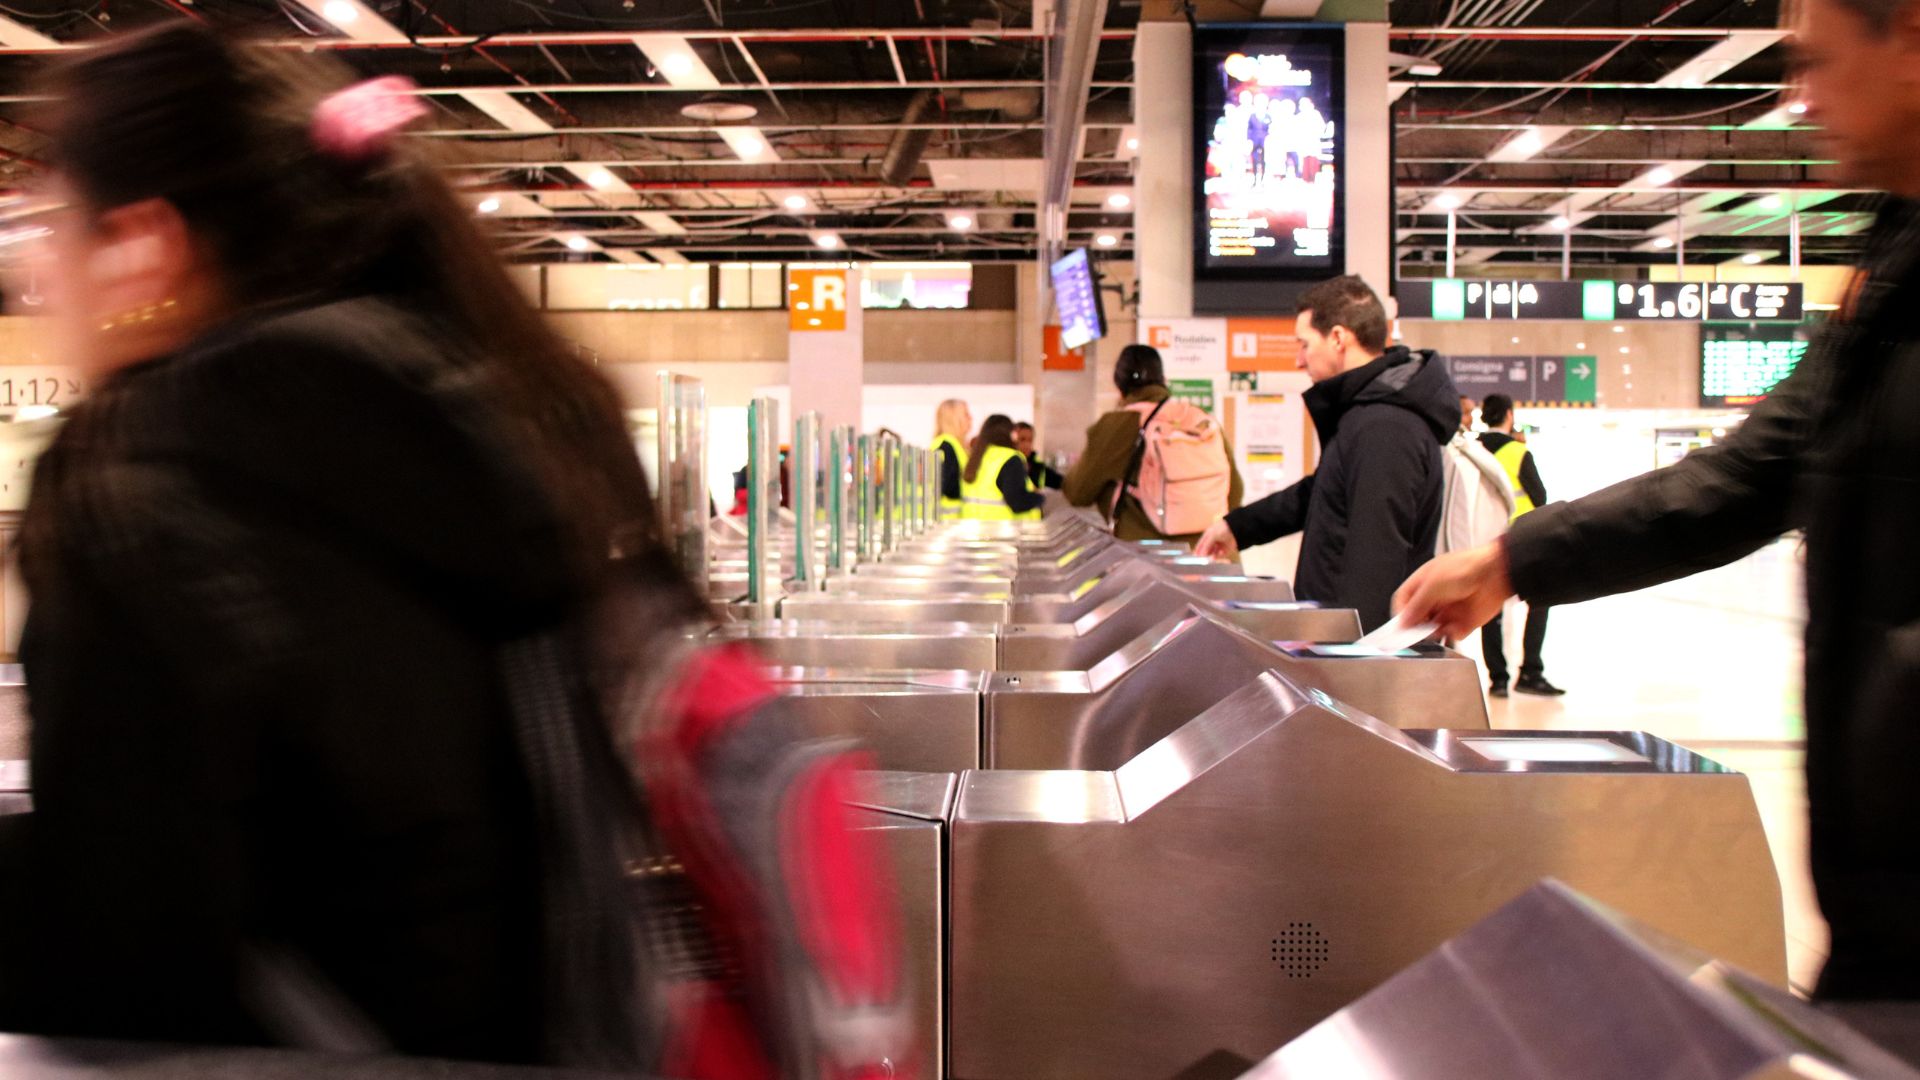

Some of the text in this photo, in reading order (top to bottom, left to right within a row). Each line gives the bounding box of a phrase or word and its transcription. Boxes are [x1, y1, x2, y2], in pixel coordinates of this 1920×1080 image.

[812, 275, 846, 311] R
[1730, 284, 1751, 318] C
[1543, 361, 1558, 381] P
